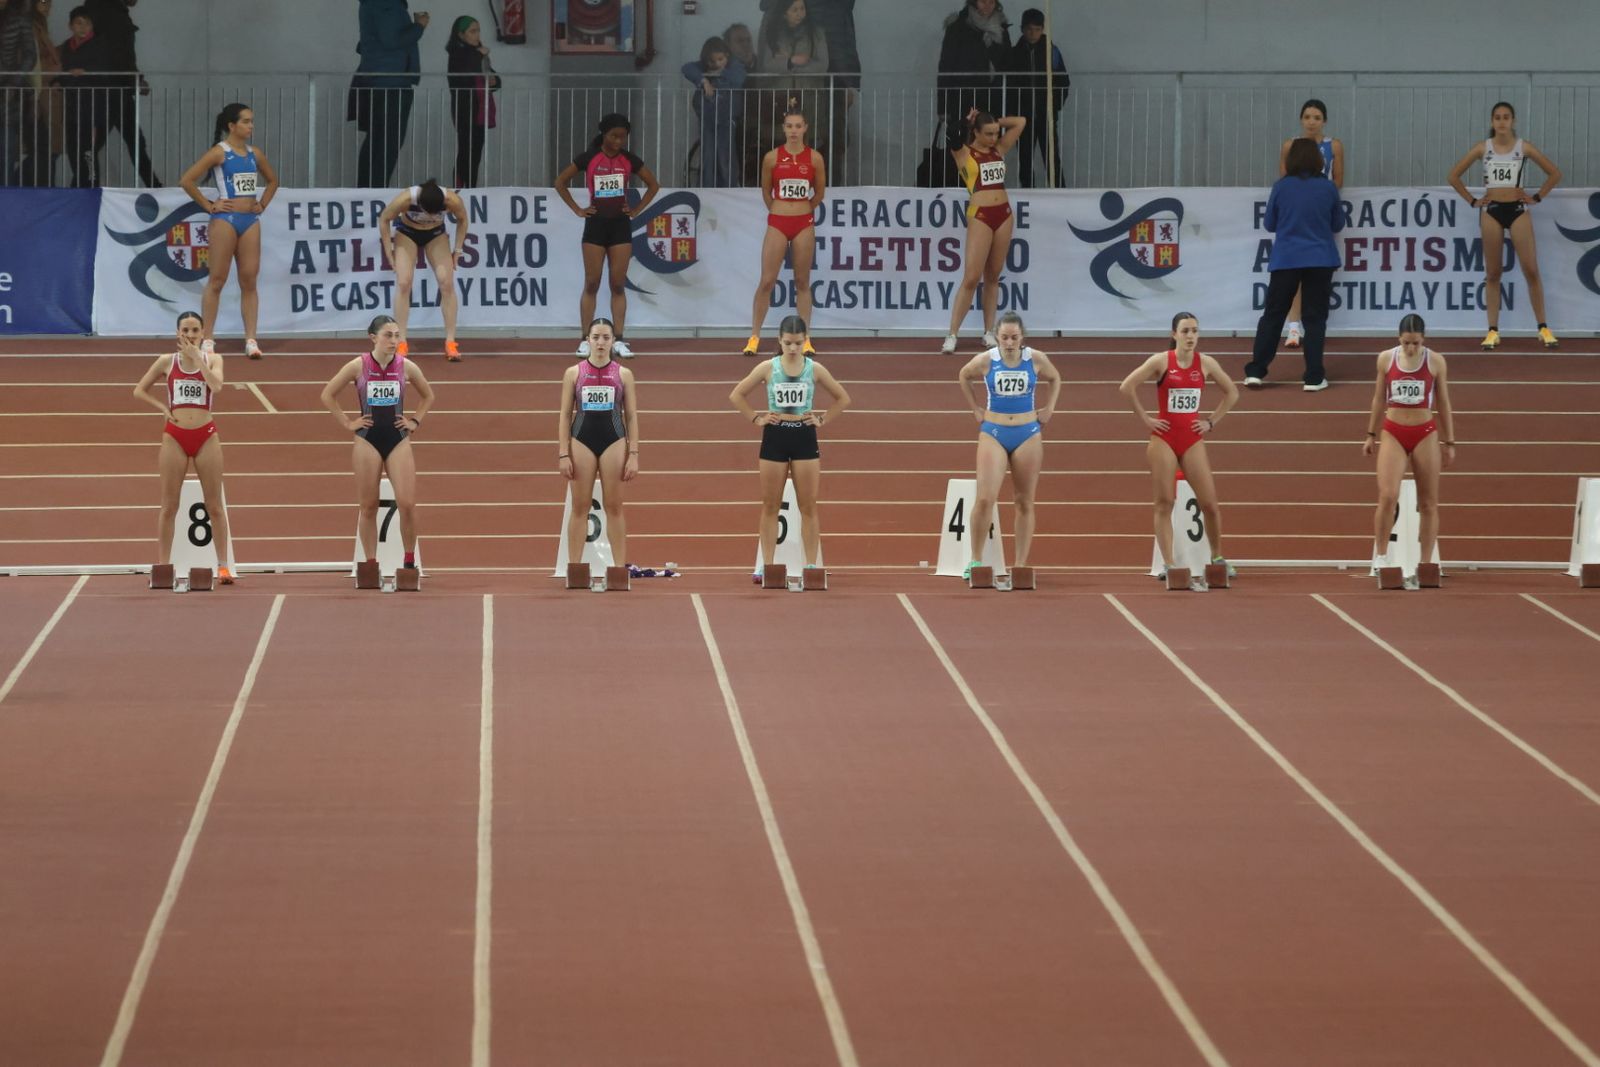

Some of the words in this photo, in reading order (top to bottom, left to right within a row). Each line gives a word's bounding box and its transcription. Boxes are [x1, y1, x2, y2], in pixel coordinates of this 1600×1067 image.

[1493, 169, 1511, 181] 184
[782, 185, 806, 197] 1540
[288, 195, 488, 231] FEDERN
[510, 195, 548, 224] DE
[1016, 201, 1030, 229] E
[1253, 193, 1457, 229] FRACIÓN
[291, 283, 325, 313] DE
[457, 277, 474, 307] Y
[480, 271, 548, 307] LEÓN
[811, 280, 932, 311] CASTILLA
[937, 281, 955, 310] Y
[1252, 282, 1268, 310] D
[1329, 281, 1417, 310] STILLA
[1422, 281, 1440, 310] Y
[179, 385, 202, 397] 1698
[373, 388, 395, 398] 2104
[587, 392, 609, 402] 2061
[776, 390, 803, 403] 3101
[997, 378, 1025, 392] 1279
[1396, 386, 1420, 397] 1700
[1171, 396, 1197, 409] 1538
[188, 502, 212, 547] 8
[379, 499, 399, 543] 7
[948, 497, 965, 541] 4
[1185, 498, 1204, 542] 3
